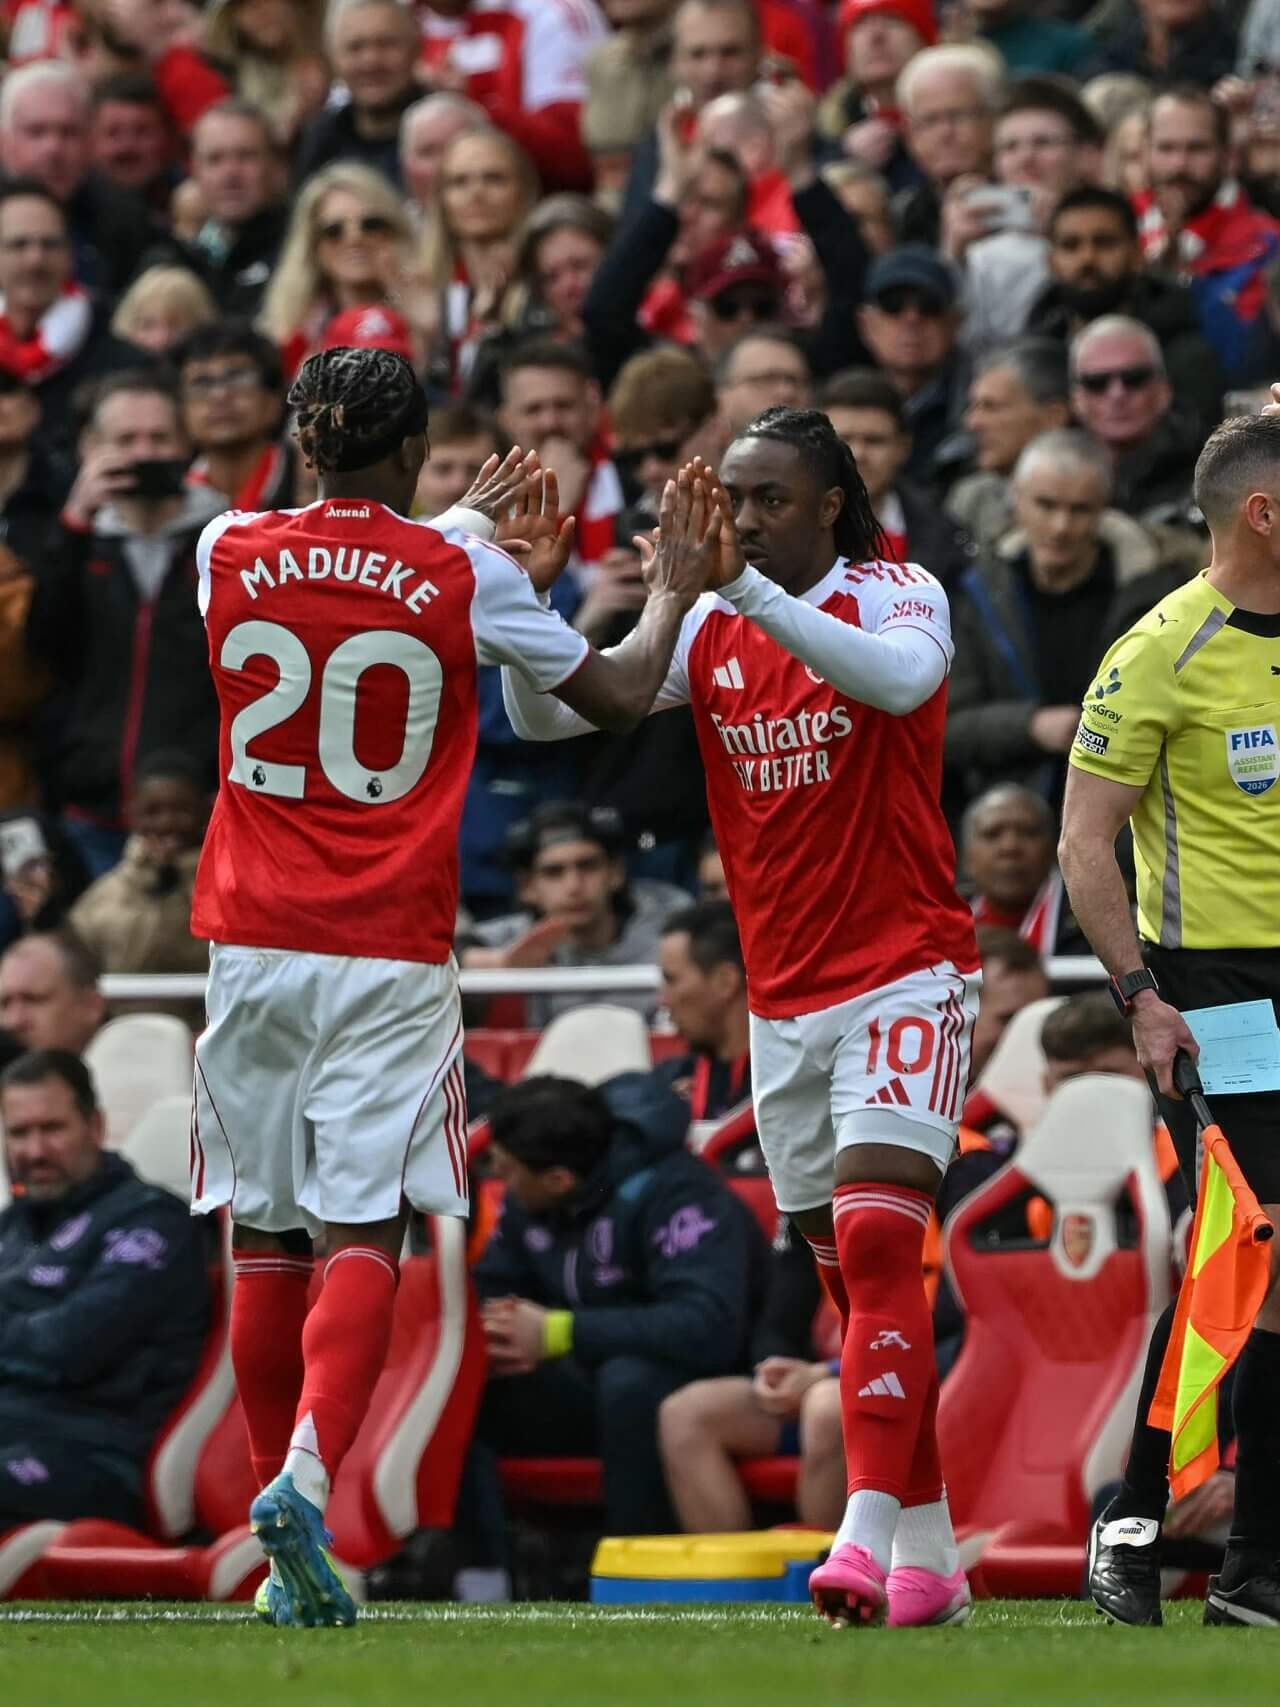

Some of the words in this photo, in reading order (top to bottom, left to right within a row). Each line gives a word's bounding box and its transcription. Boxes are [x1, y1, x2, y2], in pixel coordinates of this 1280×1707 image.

[326, 505, 370, 518] Arsenal
[239, 547, 440, 616] MADUEKE
[219, 619, 444, 805] 20
[1231, 729, 1275, 751] FIFA
[1234, 753, 1277, 766] ASSISTANT
[1237, 762, 1274, 774] REFEREE
[760, 749, 832, 793] BETTER
[1247, 781, 1268, 791] 2026
[865, 1015, 936, 1076] 10
